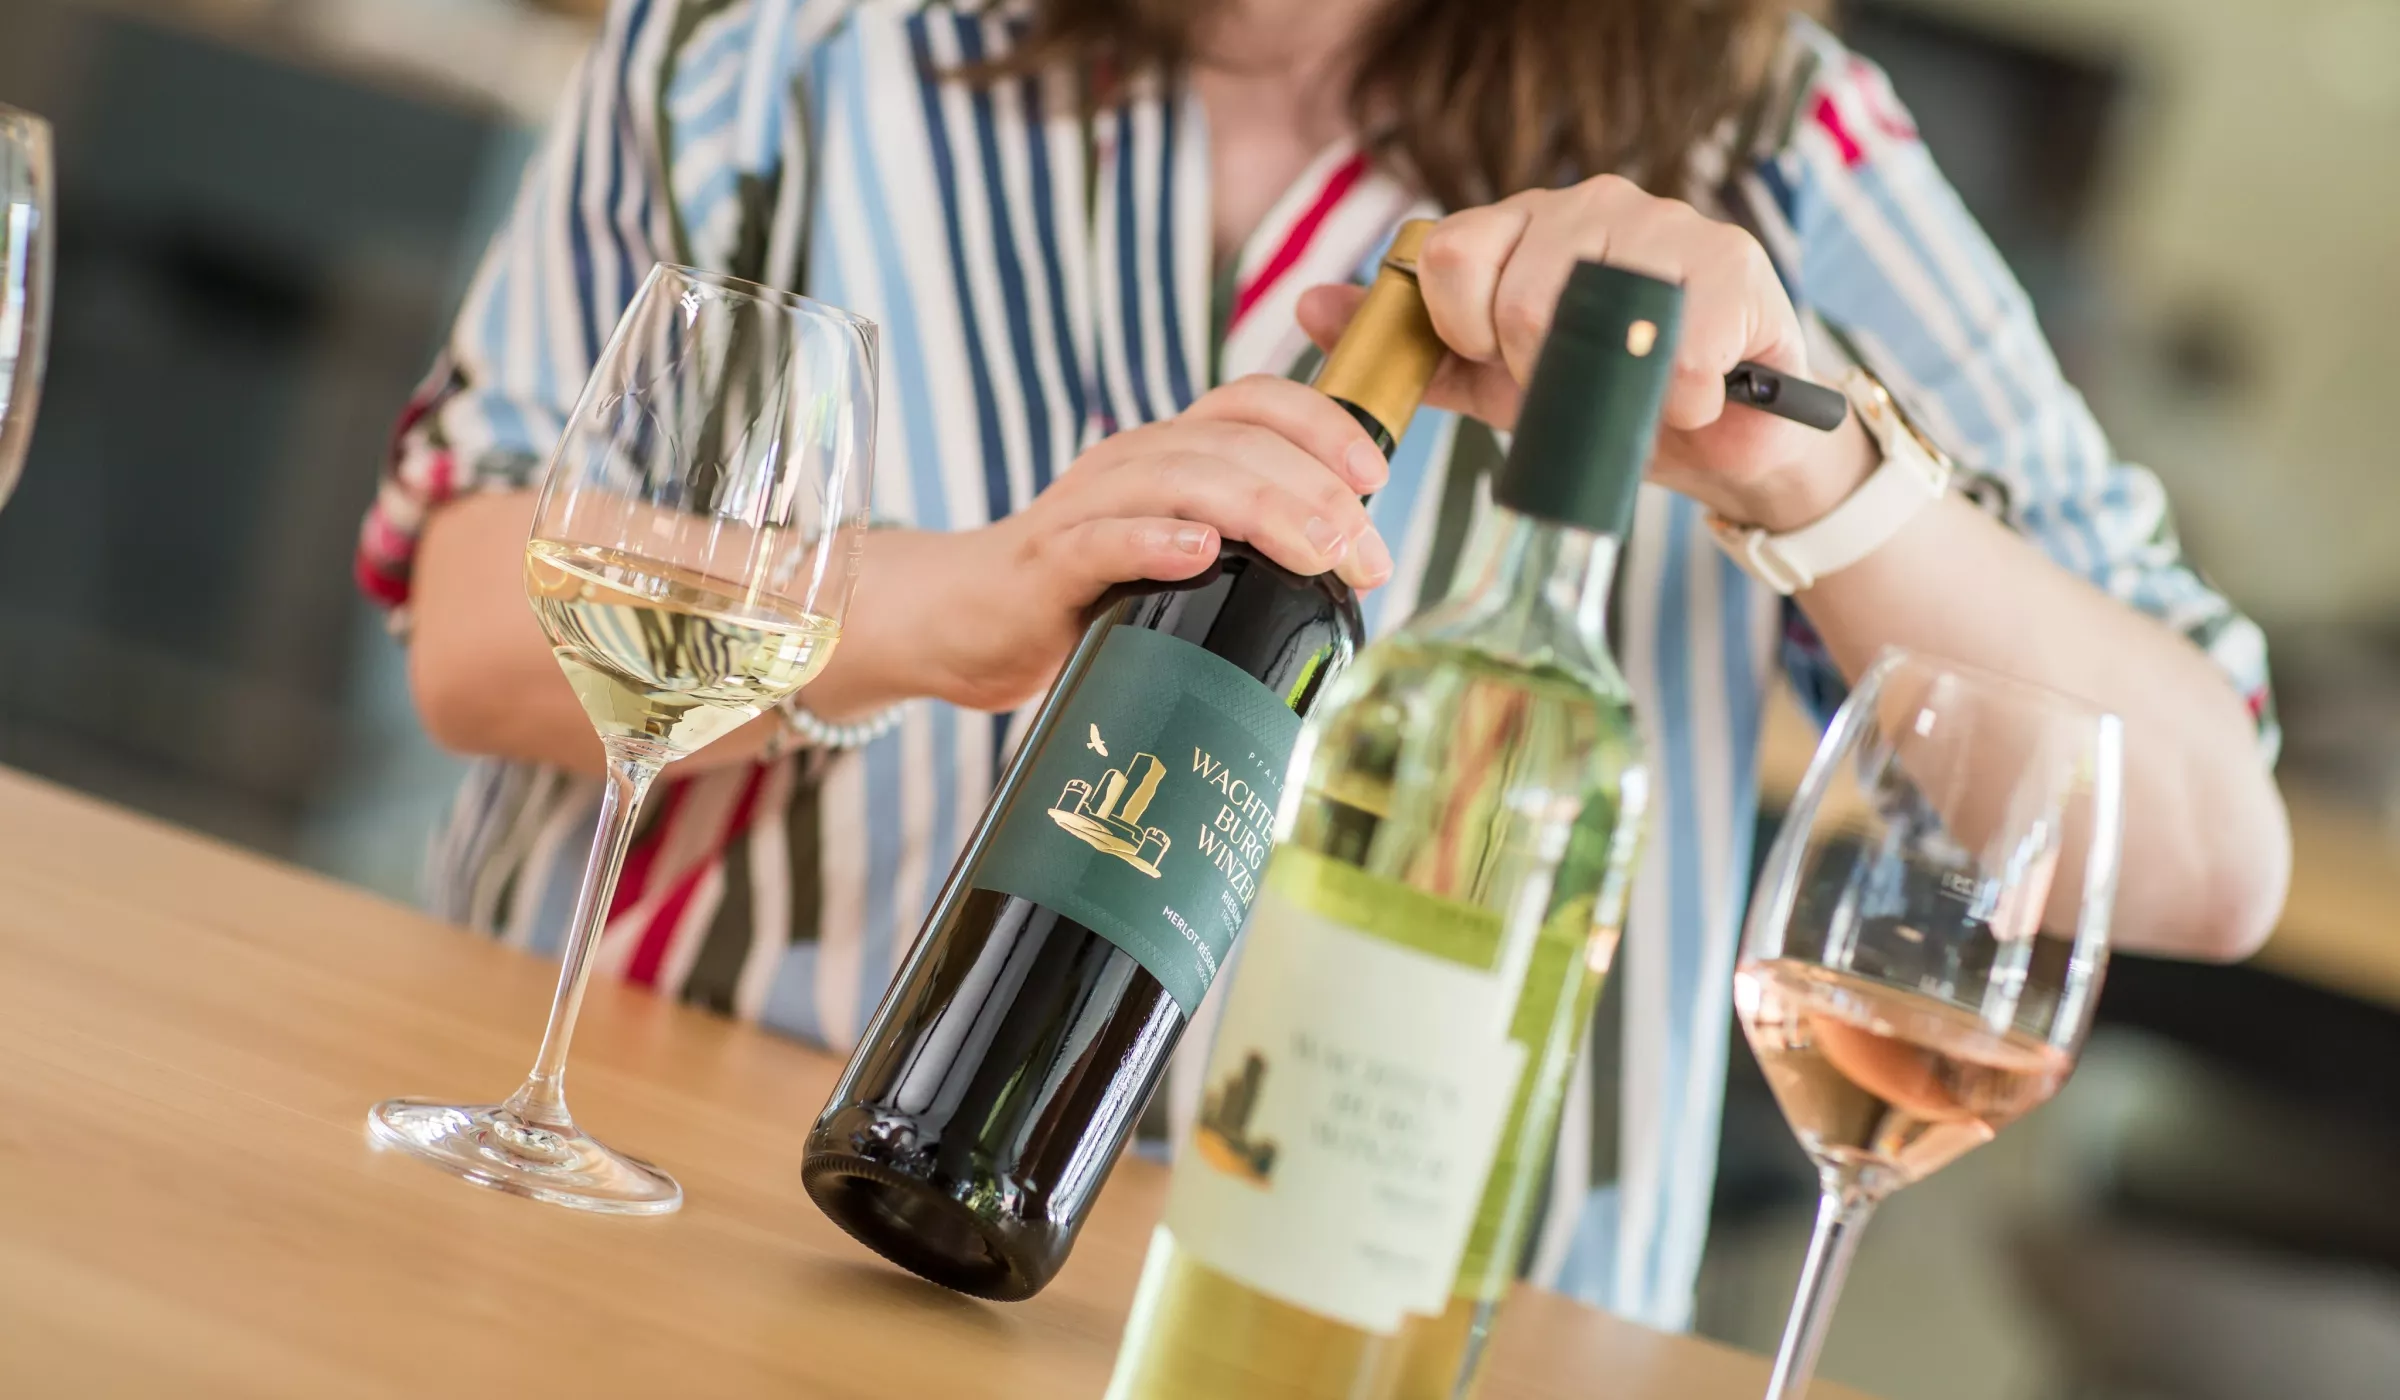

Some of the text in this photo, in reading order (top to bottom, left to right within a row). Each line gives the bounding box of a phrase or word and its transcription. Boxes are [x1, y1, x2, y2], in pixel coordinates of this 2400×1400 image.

[1199, 823, 1255, 910] WINZER
[1214, 804, 1265, 870] BURG
[1163, 906, 1200, 945] MERLOT
